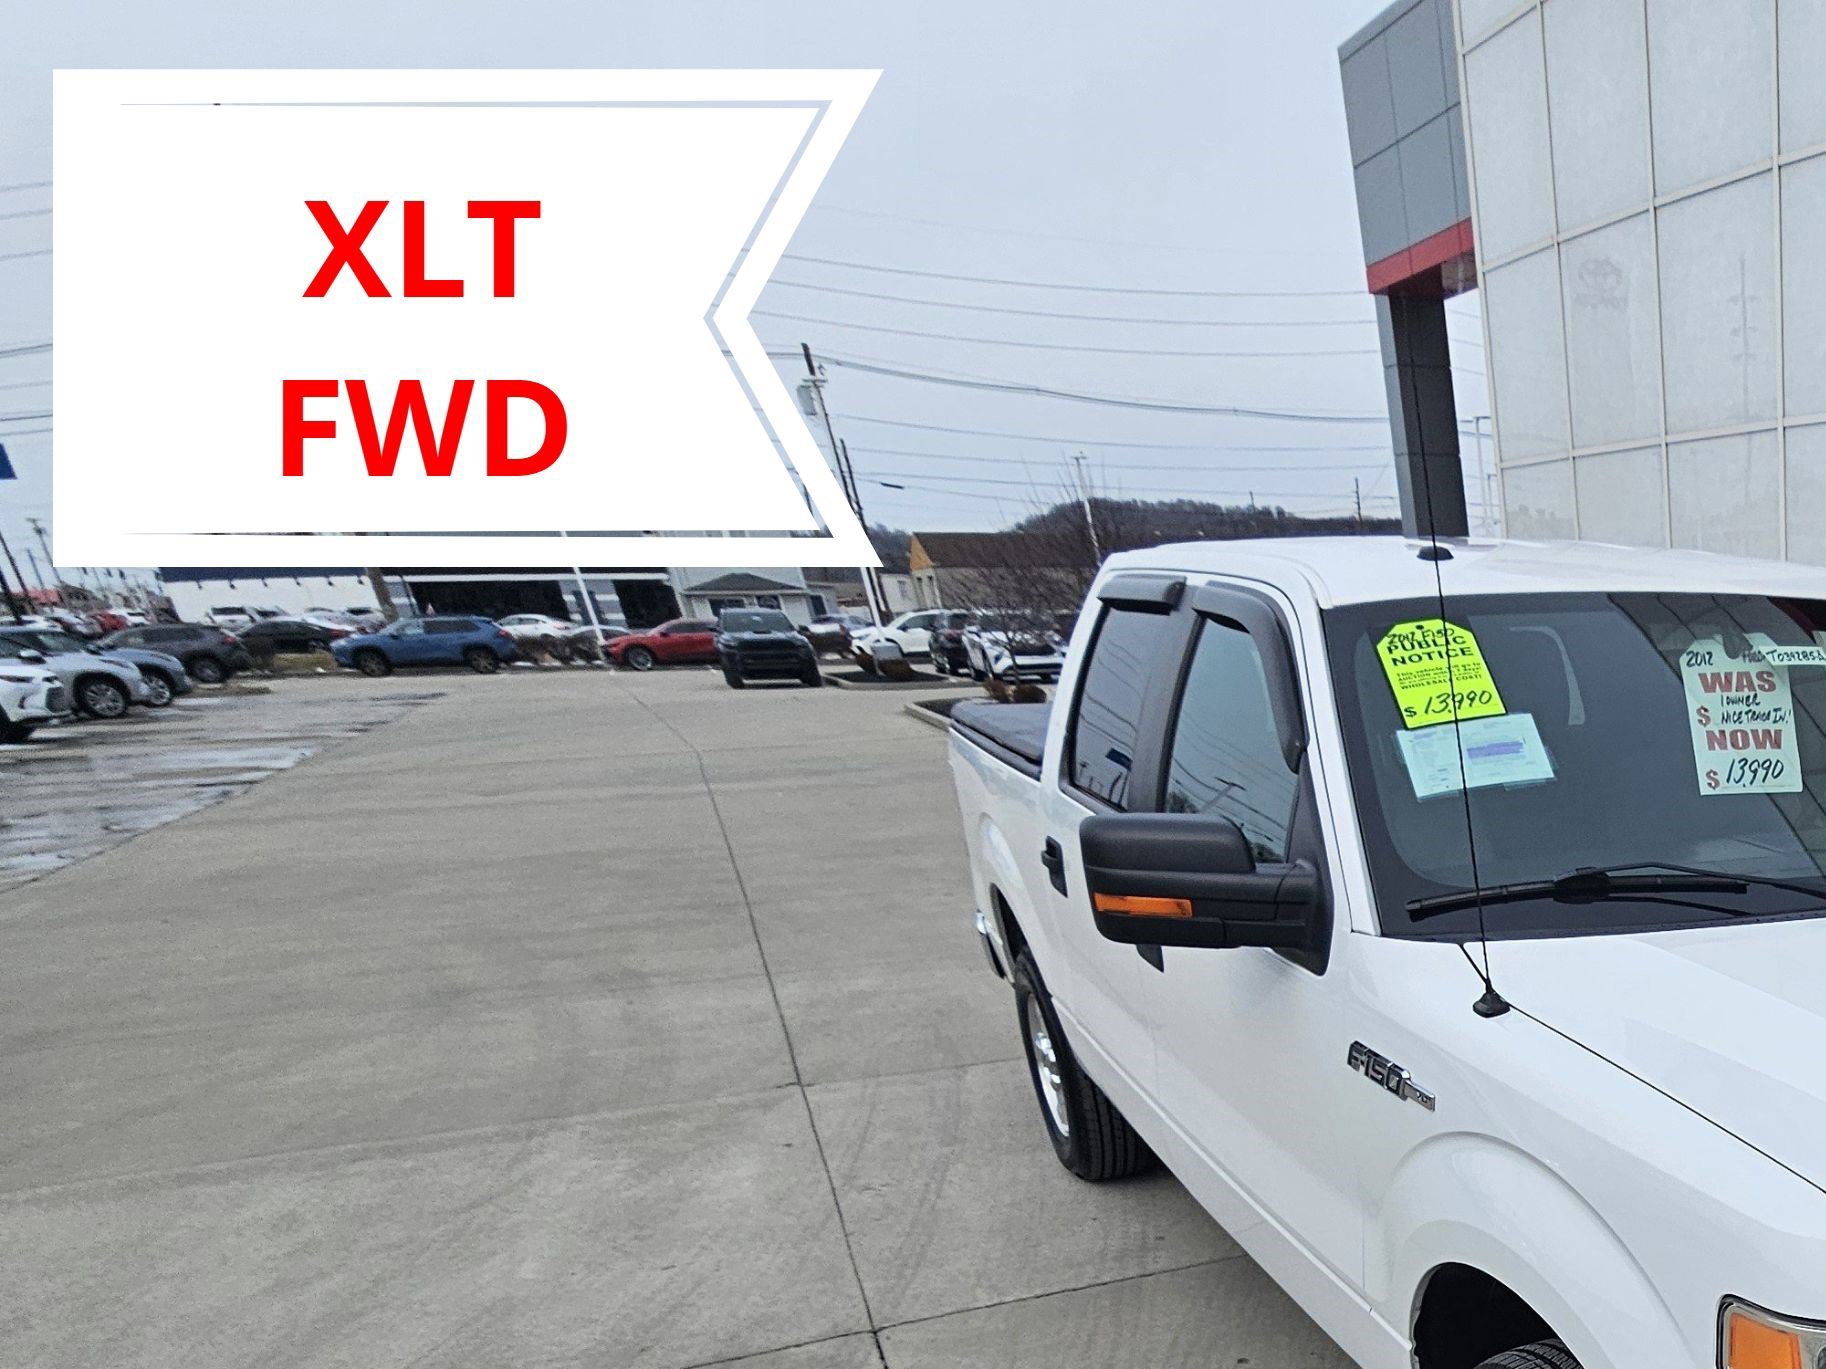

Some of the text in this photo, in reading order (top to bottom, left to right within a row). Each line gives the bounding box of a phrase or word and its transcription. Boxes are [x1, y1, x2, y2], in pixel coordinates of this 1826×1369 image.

[1391, 647, 1474, 666] NOTICE
[1686, 651, 1713, 668] 2012
[1400, 679, 1451, 690] WHOLESAL
[1698, 670, 1776, 693] WAS
[1404, 706, 1417, 718] $
[1696, 705, 1711, 727] $
[1721, 710, 1743, 724] NICE
[1705, 729, 1782, 751] NOW
[1705, 769, 1720, 790] $
